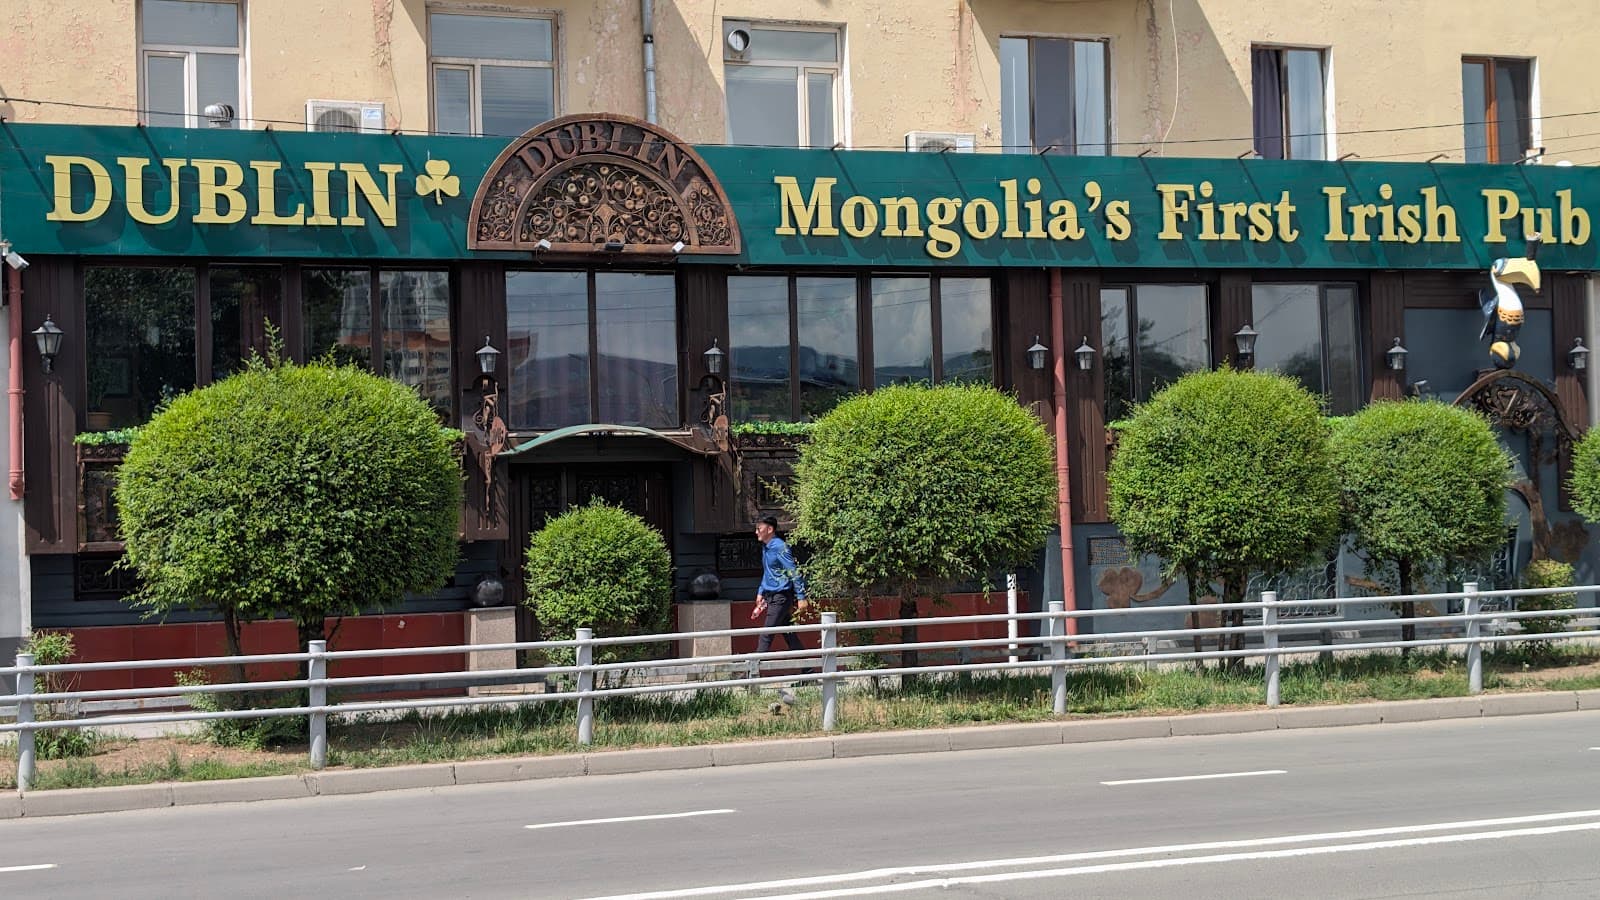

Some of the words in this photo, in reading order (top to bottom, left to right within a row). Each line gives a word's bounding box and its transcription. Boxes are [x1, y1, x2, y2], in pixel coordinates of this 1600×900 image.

[516, 122, 691, 181] DUBLIN
[45, 155, 403, 227] DUBLIN
[774, 176, 1131, 258] Mongolia's
[1157, 181, 1298, 242] First
[1322, 184, 1460, 244] Irish
[1481, 189, 1590, 245] Pub
